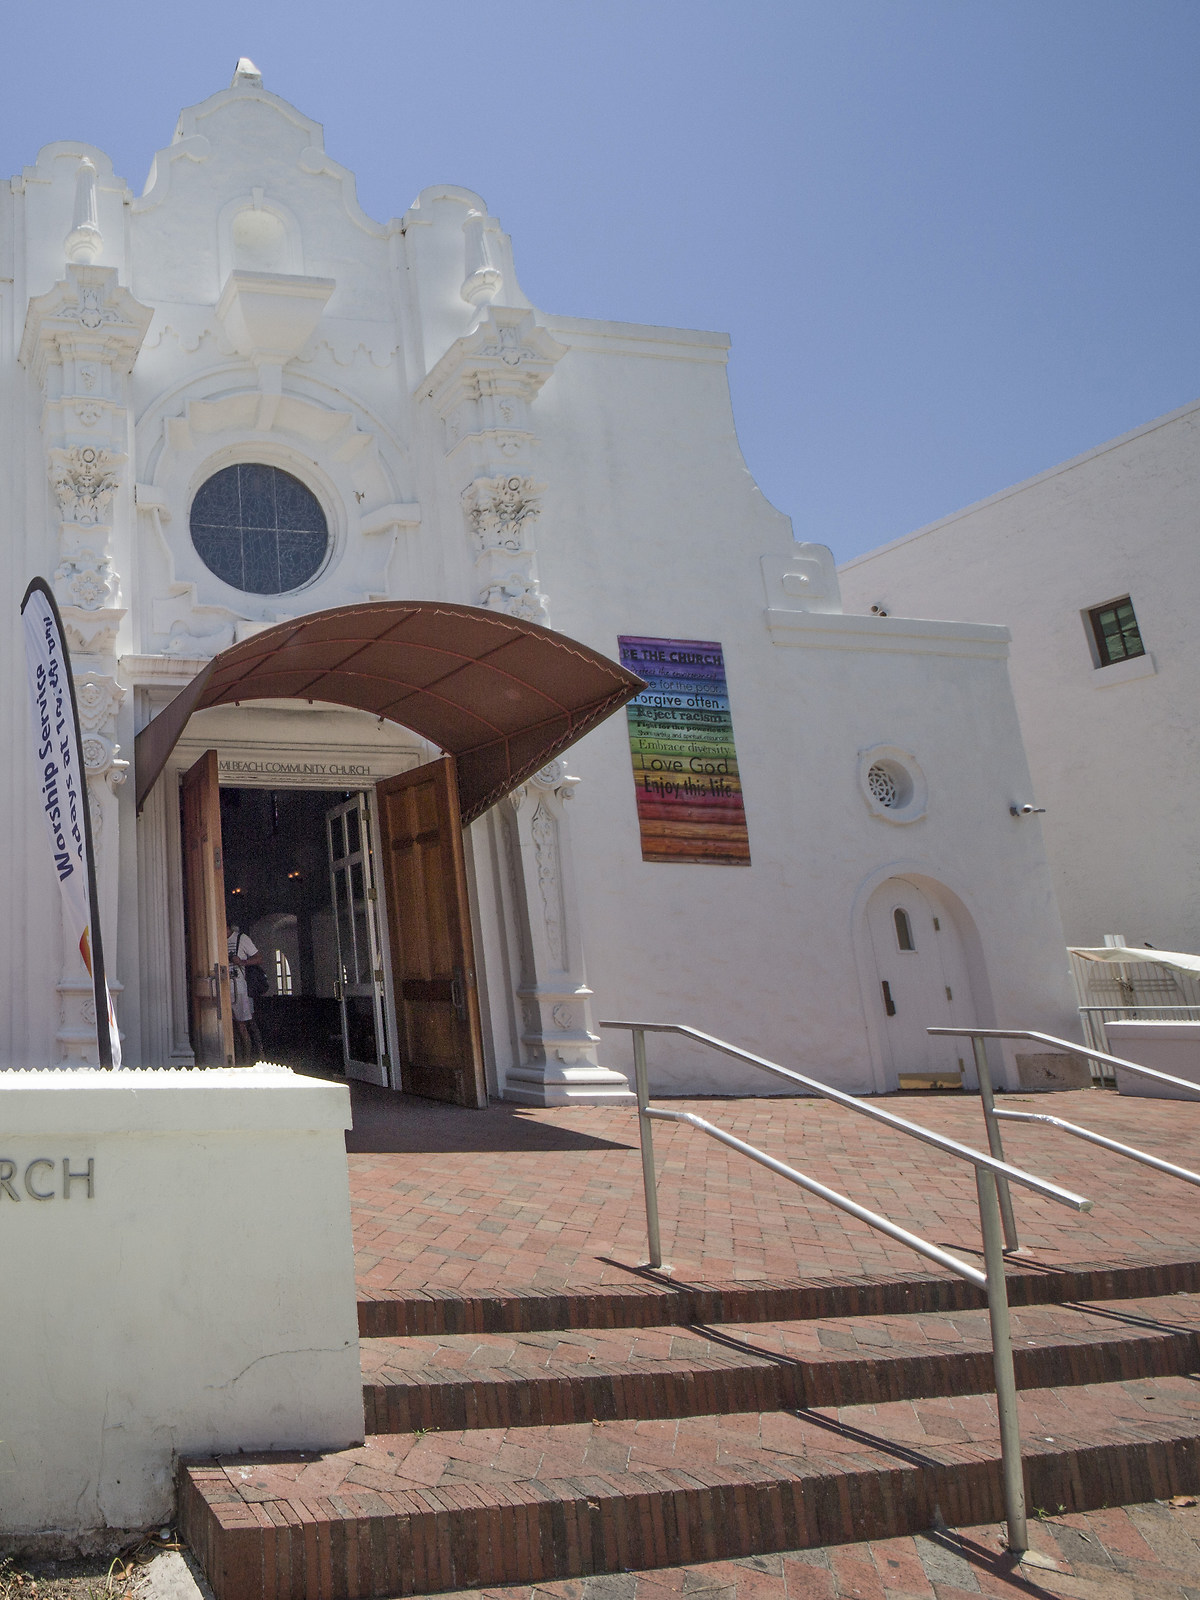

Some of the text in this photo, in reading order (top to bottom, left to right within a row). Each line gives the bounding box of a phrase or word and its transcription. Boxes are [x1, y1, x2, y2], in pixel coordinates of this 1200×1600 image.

[622, 648, 722, 666] BE THE CHURCH
[659, 679, 674, 690] for
[676, 680, 693, 691] the
[686, 693, 725, 709] often.
[636, 706, 727, 723] Reject racism.
[59, 738, 71, 771] at
[639, 739, 686, 752] Embrace
[232, 761, 264, 772] BEACH
[265, 762, 327, 774] COMMUNITY
[329, 764, 370, 776] CHURCH
[641, 754, 683, 772] Love
[36, 663, 75, 882] Worship Service
[643, 775, 735, 800] Enjoy this life.
[66, 776, 84, 862] ndays
